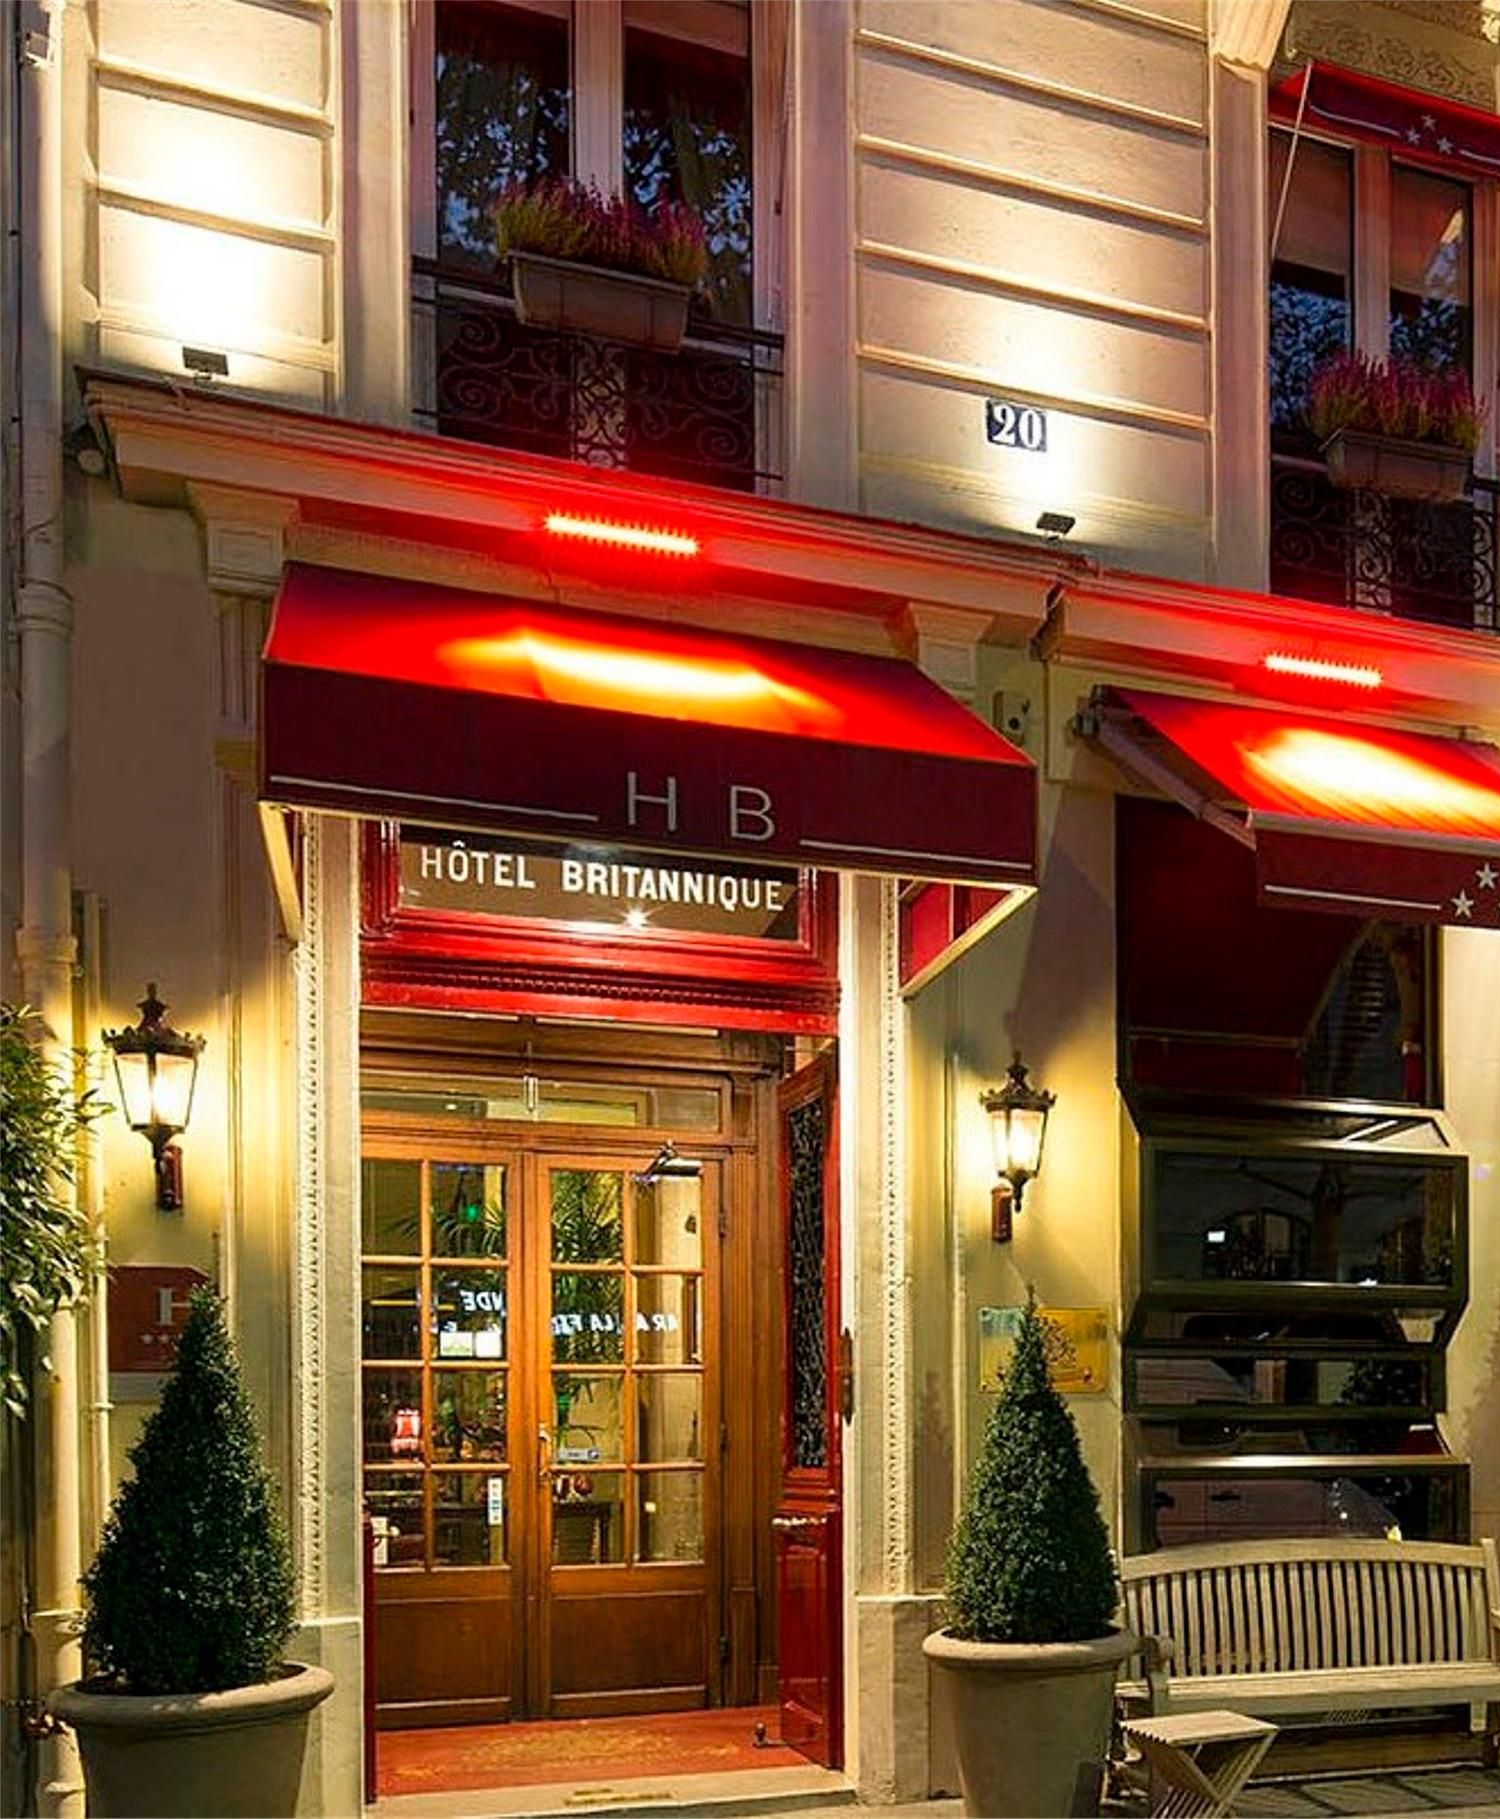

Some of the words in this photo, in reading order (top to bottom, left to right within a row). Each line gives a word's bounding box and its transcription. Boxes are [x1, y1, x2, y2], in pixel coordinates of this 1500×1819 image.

[992, 404, 1042, 449] 20
[627, 771, 677, 833] H
[729, 785, 775, 842] B
[420, 840, 536, 890] HÔTEL
[561, 860, 784, 913] BRITANNIQUE
